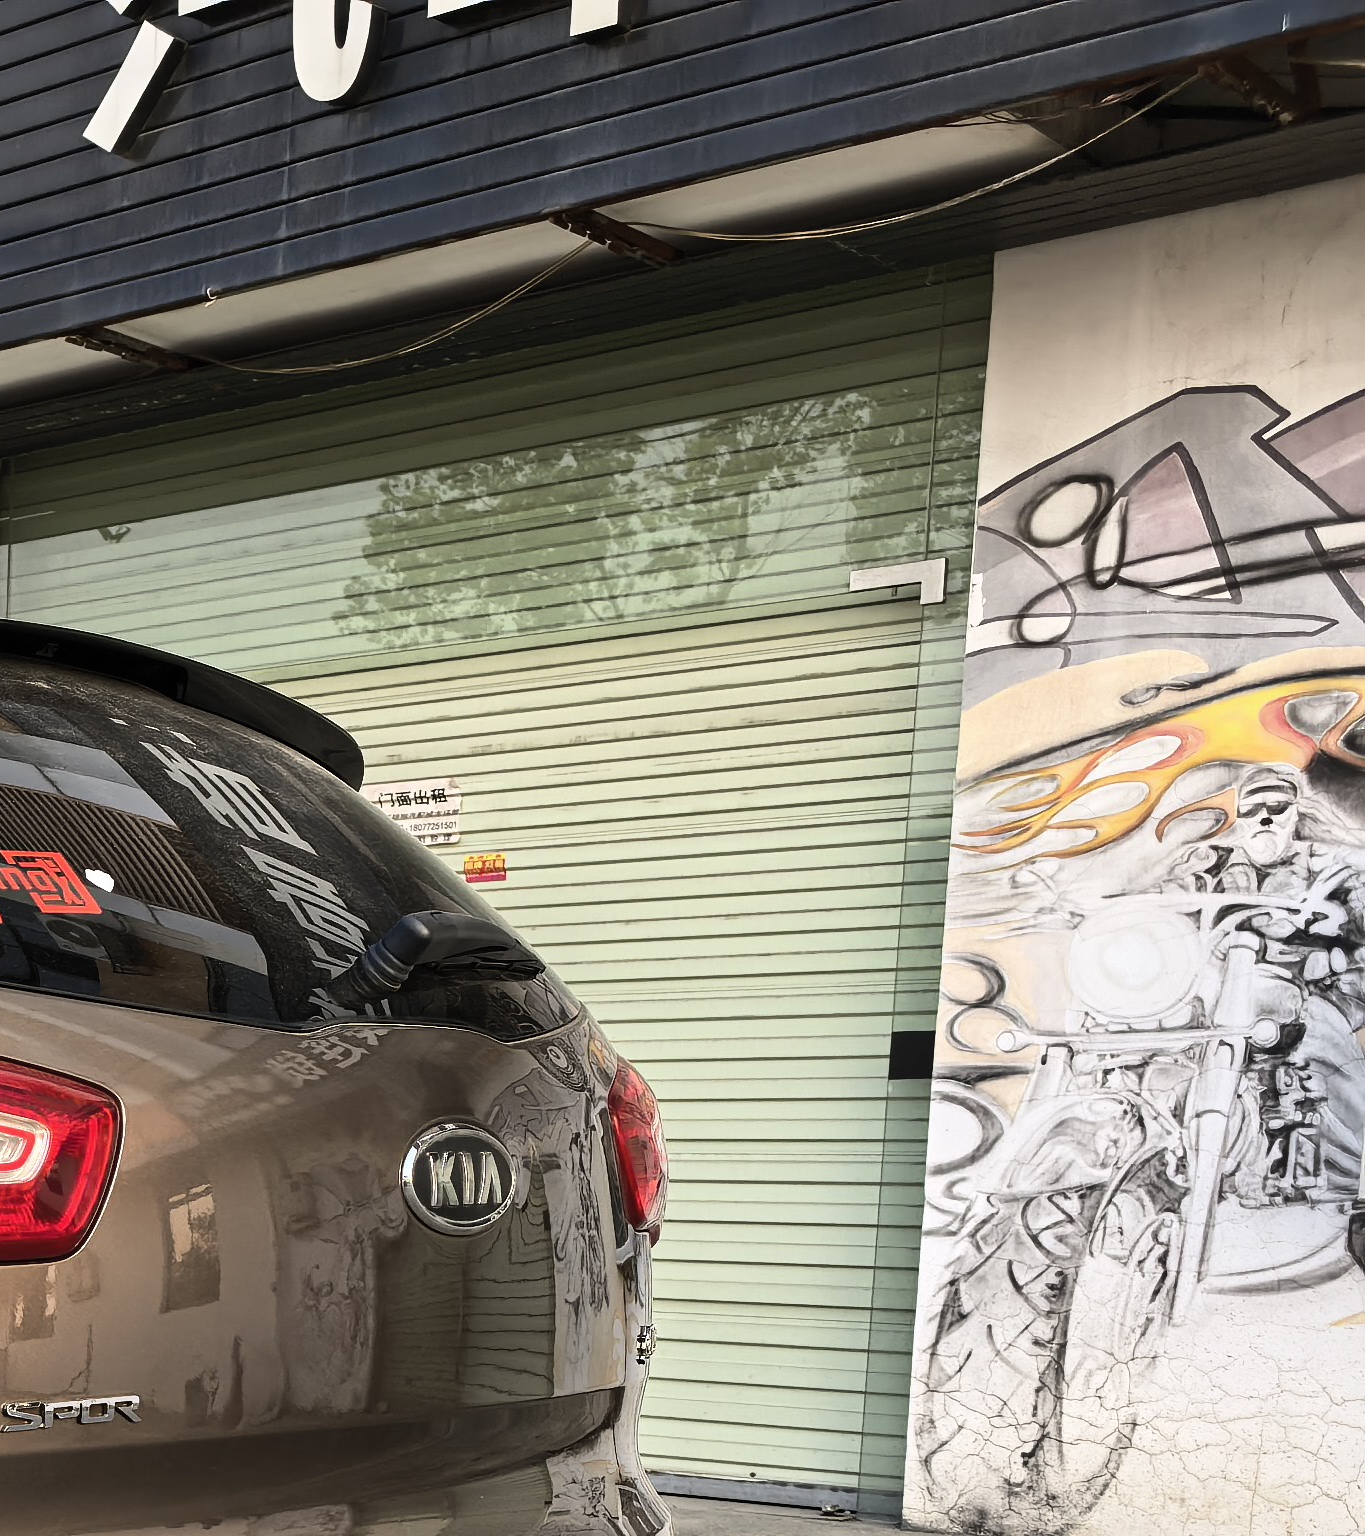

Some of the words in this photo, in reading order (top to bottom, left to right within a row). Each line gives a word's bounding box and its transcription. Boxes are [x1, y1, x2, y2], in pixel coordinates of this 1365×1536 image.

[378, 788, 448, 808] 门面出租
[426, 1150, 504, 1208] KIA
